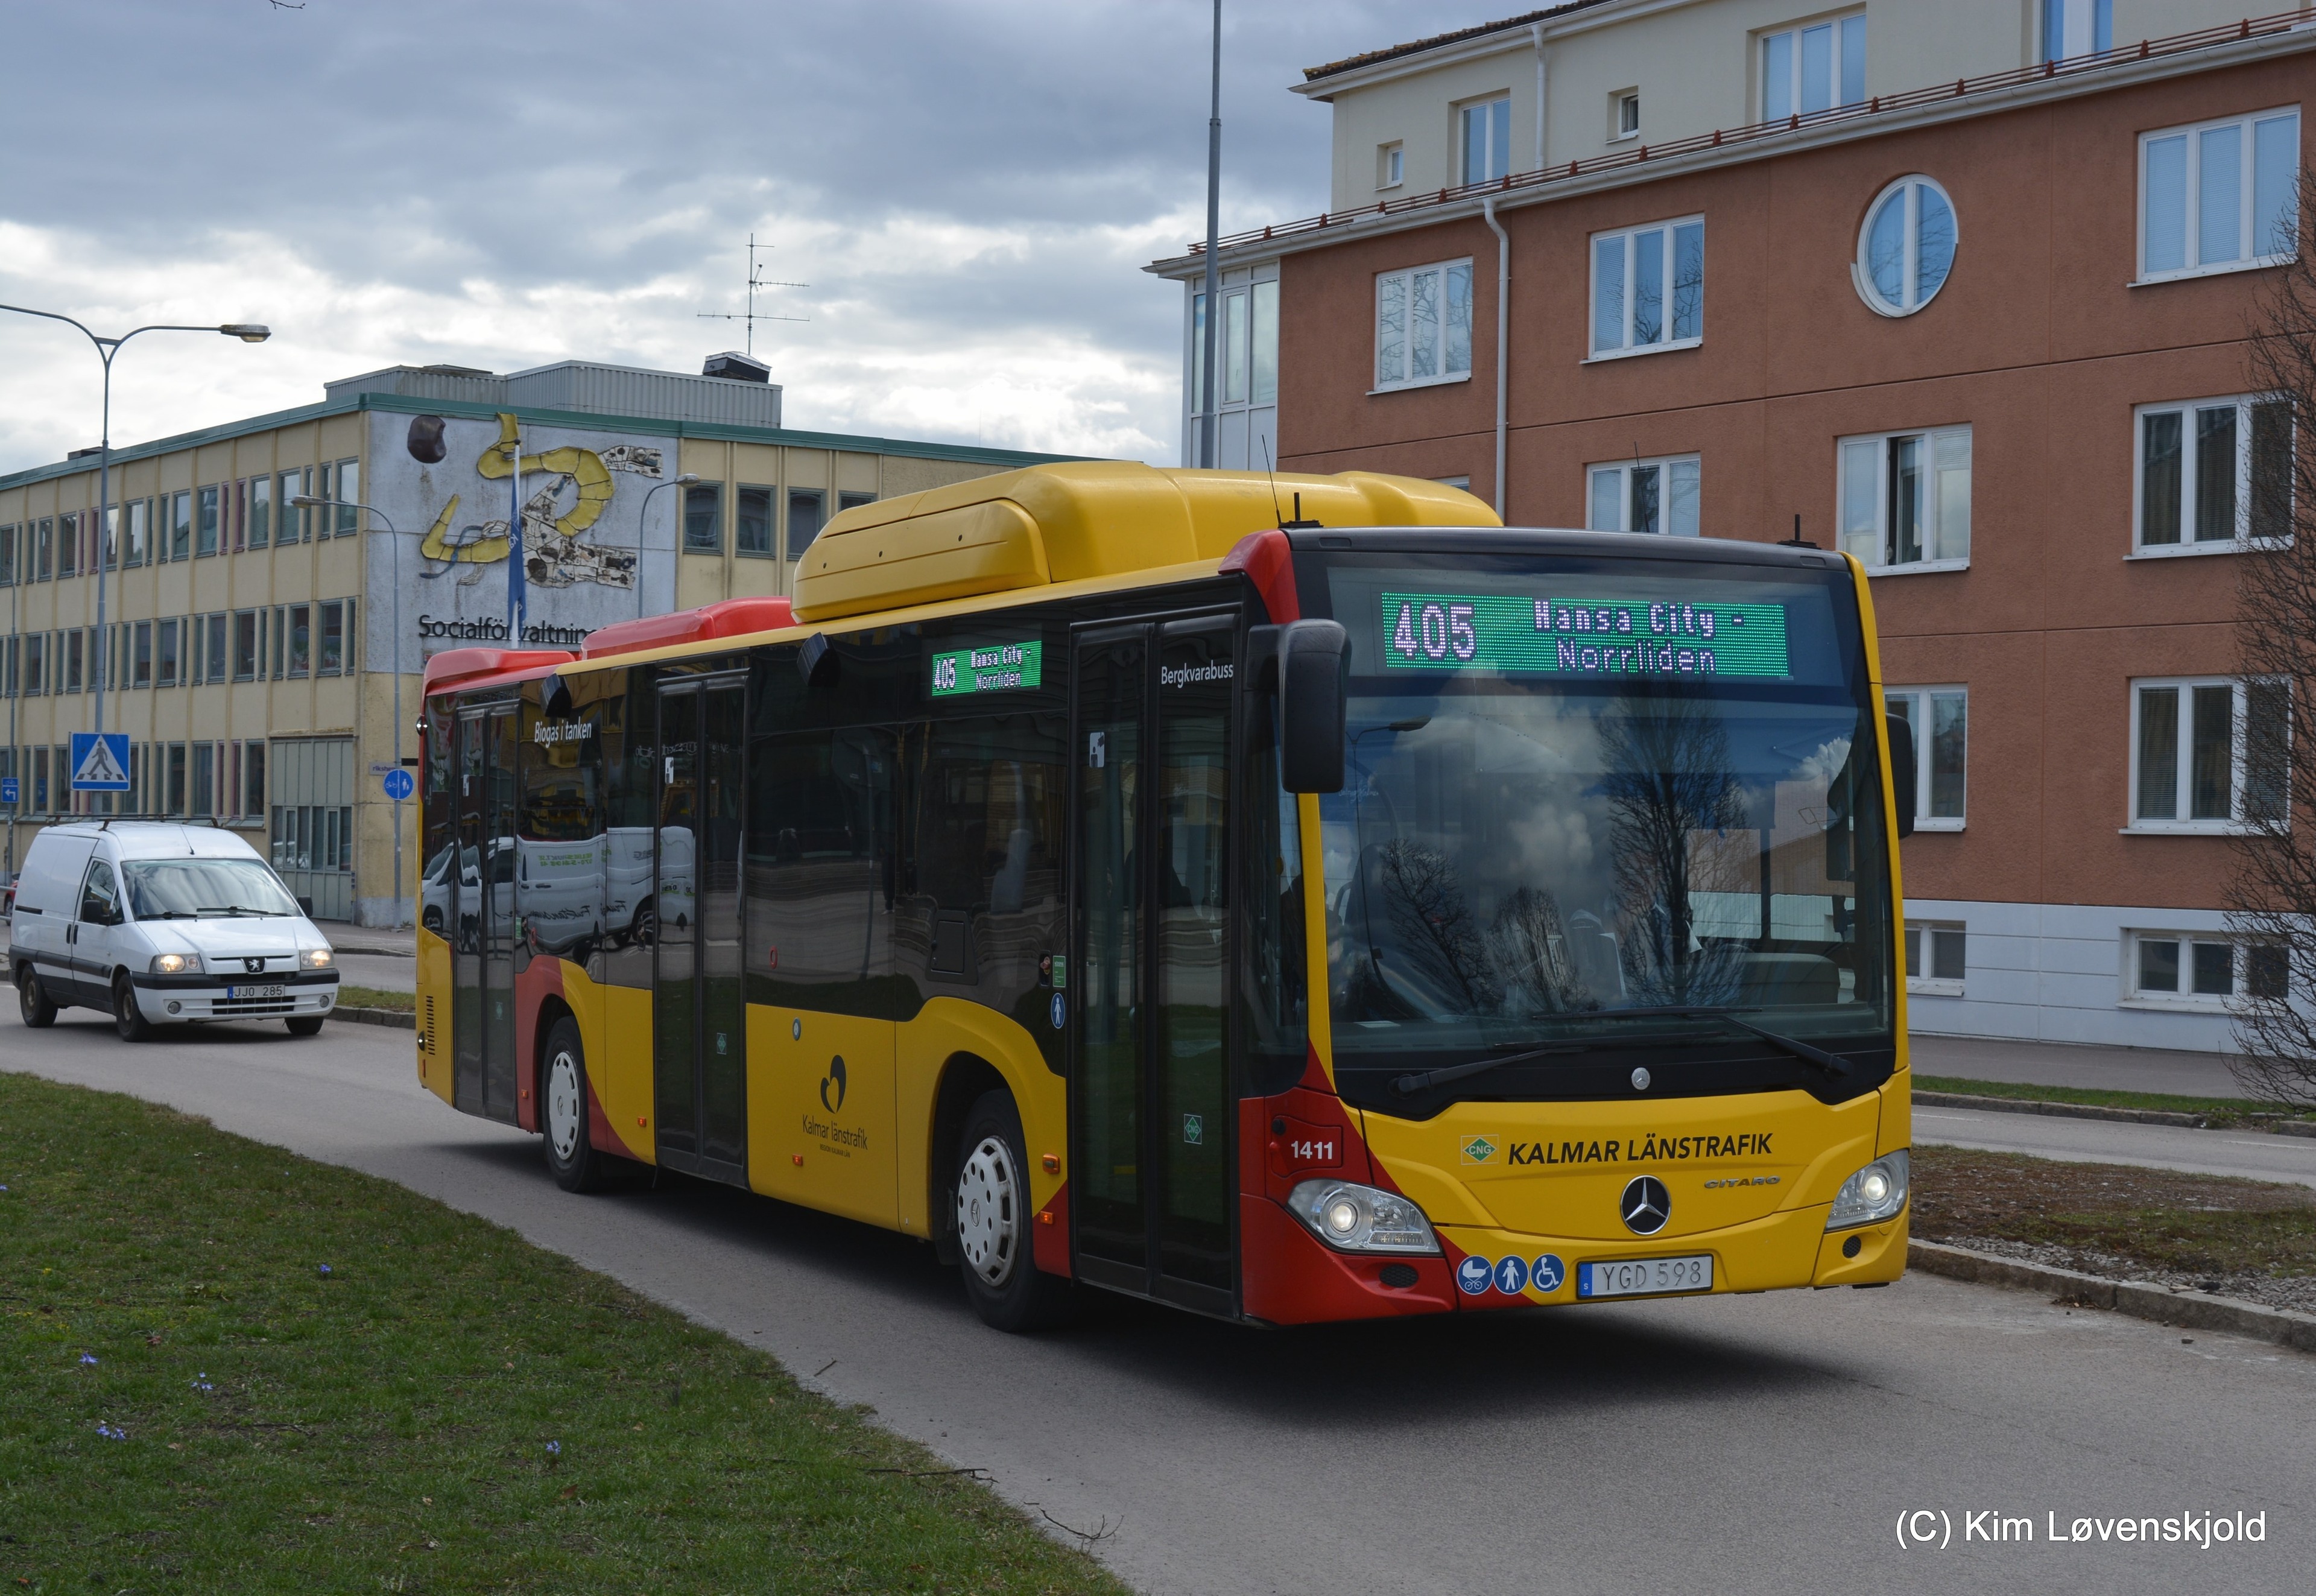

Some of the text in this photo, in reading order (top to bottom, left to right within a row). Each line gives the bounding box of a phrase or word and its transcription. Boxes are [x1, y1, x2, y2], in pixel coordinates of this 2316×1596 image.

[418, 614, 597, 644] Socialförvaltnin
[1394, 604, 1475, 658] 405
[1534, 600, 1631, 631] Hansa
[1650, 604, 1714, 637] City
[1557, 639, 1716, 672] Norrliden
[934, 657, 957, 689] 405
[1161, 659, 1234, 689] Bergkvarabuss
[534, 715, 592, 749] Biogas i tanken
[235, 986, 283, 997] JJO 285
[802, 1114, 868, 1150] Kalmar länstrafik
[1187, 1124, 1198, 1134] CNG
[1291, 1140, 1333, 1160] 1411
[1468, 1145, 1492, 1155] CNG
[1508, 1132, 1774, 1165] KALMAR LÄNSTRAFIK
[1704, 1175, 1781, 1189] CITARO
[1602, 1264, 1647, 1291] YGD
[1656, 1260, 1701, 1287] 598
